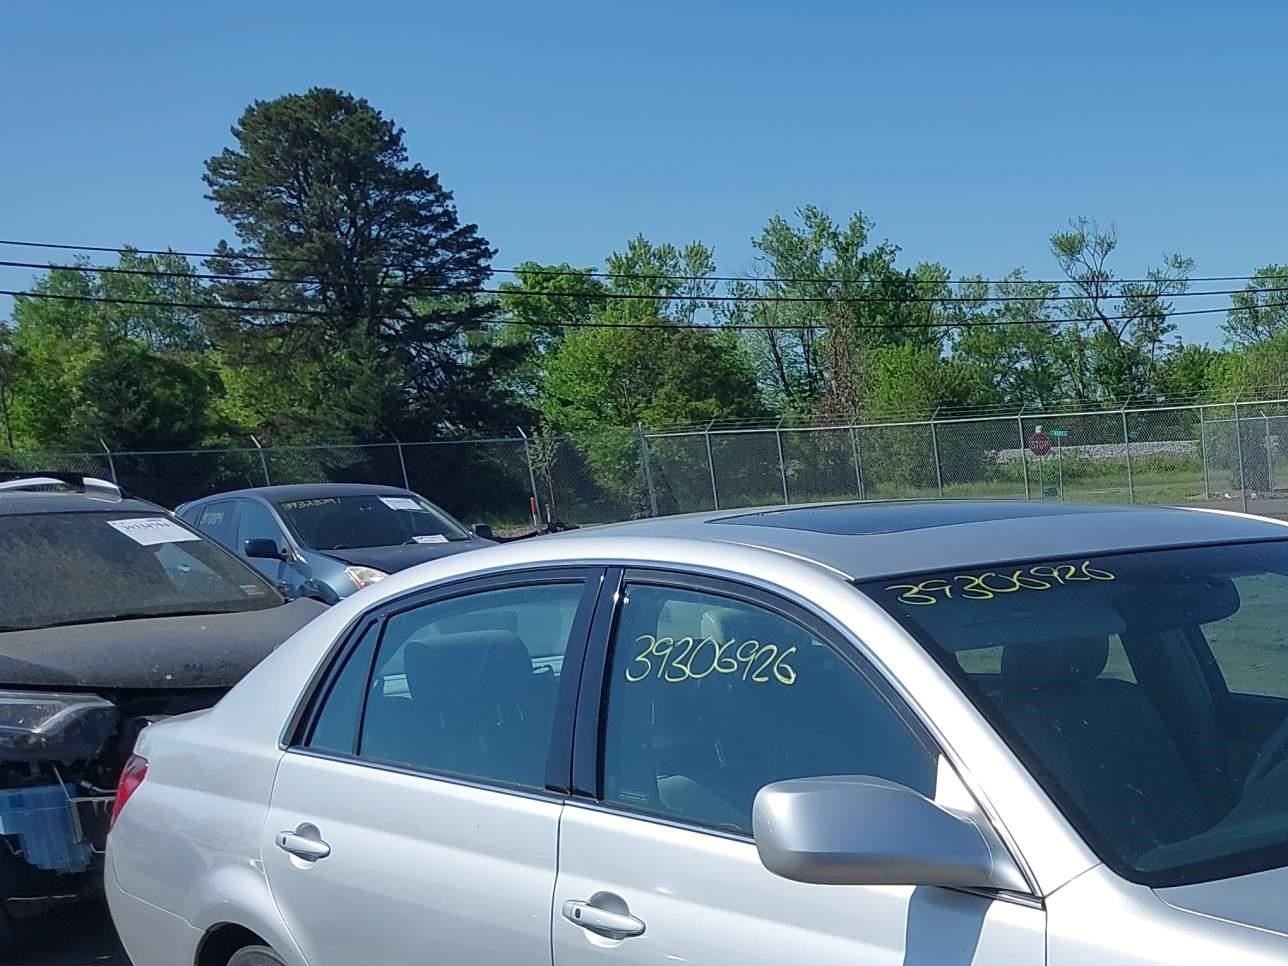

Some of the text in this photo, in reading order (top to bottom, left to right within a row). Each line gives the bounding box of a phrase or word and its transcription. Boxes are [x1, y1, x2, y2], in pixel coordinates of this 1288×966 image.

[1031, 440, 1050, 449] STOP
[884, 560, 1116, 606] 39306926
[626, 634, 797, 685] 39306926
